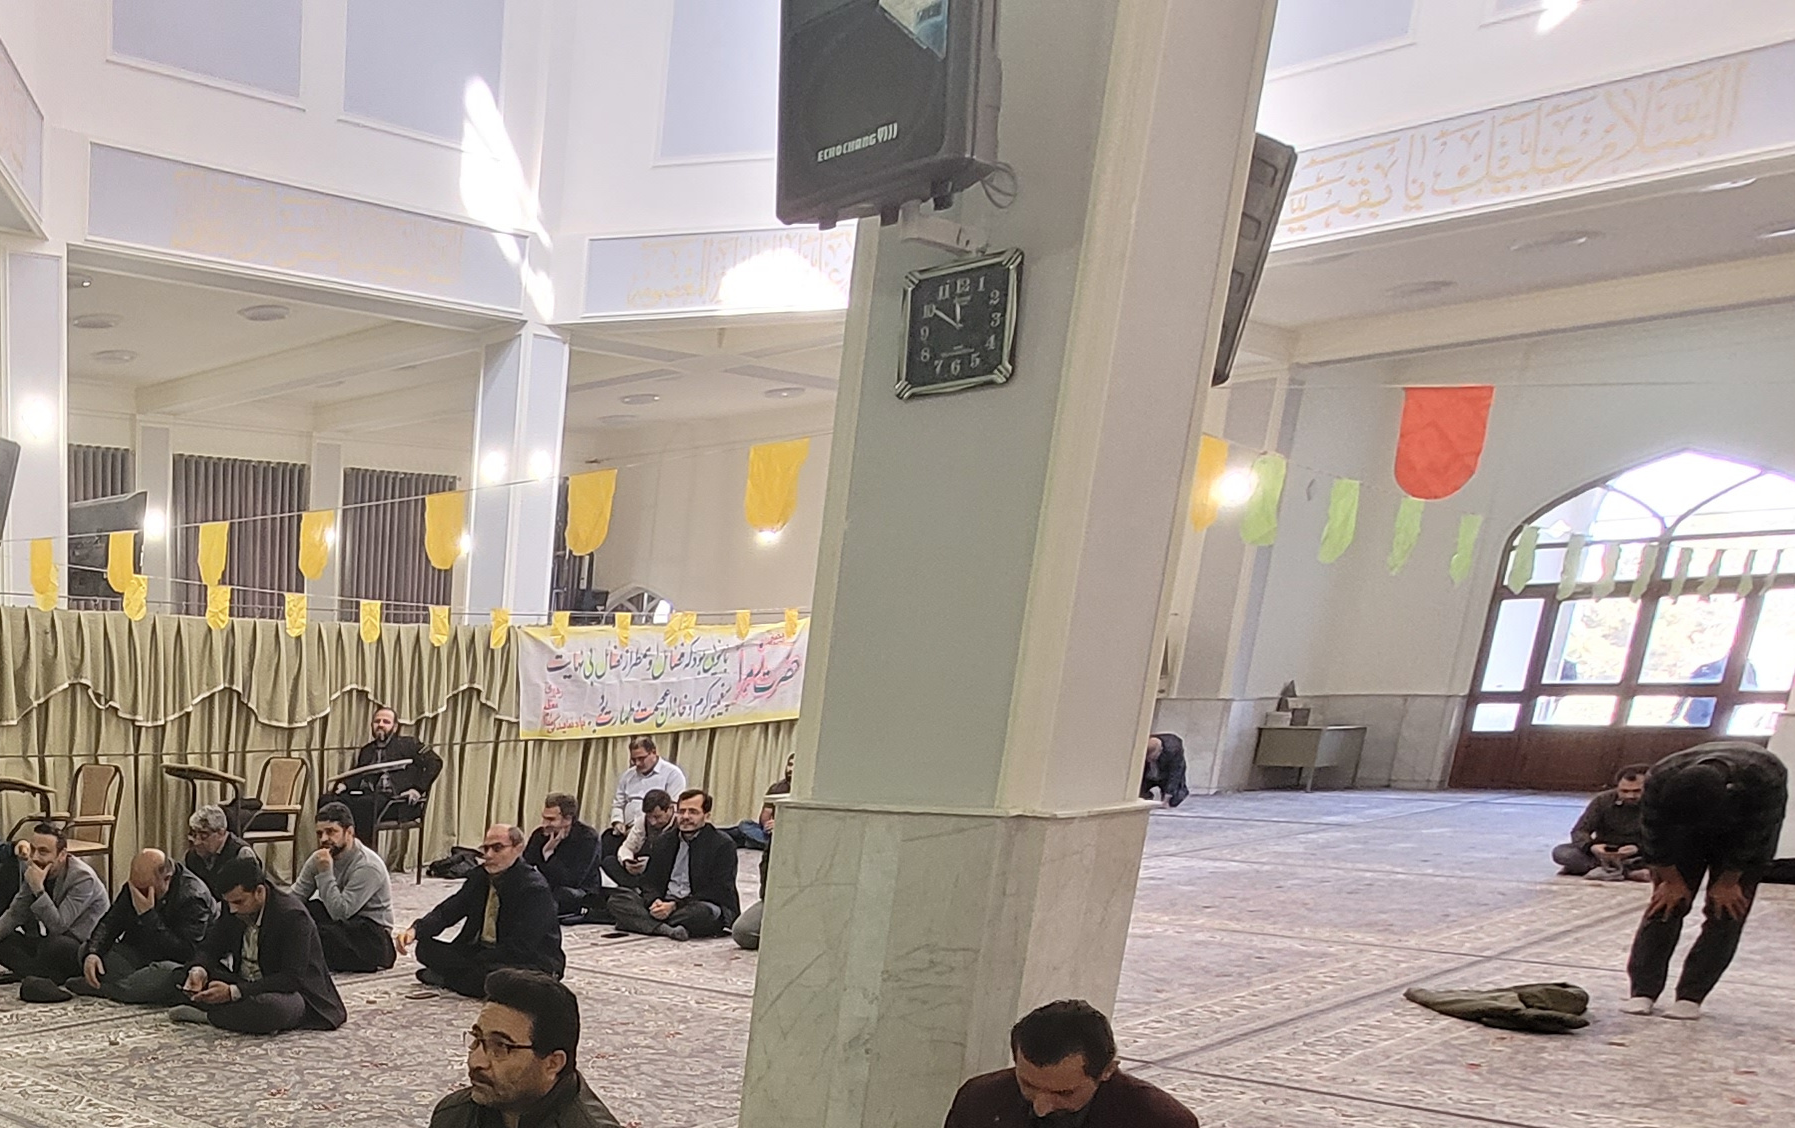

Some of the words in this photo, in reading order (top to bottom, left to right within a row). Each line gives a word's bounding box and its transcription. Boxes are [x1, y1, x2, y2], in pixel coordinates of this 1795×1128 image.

[936, 280, 951, 301] 11
[955, 277, 970, 294] 12
[978, 276, 986, 292] 1
[988, 289, 1000, 305] 2
[922, 303, 936, 319] 10
[990, 312, 1002, 327] 3
[920, 326, 929, 341] 9
[984, 334, 996, 350] 4
[920, 347, 931, 362] 8
[970, 352, 981, 368] 5
[934, 359, 944, 375] 7
[950, 359, 961, 375] 6
